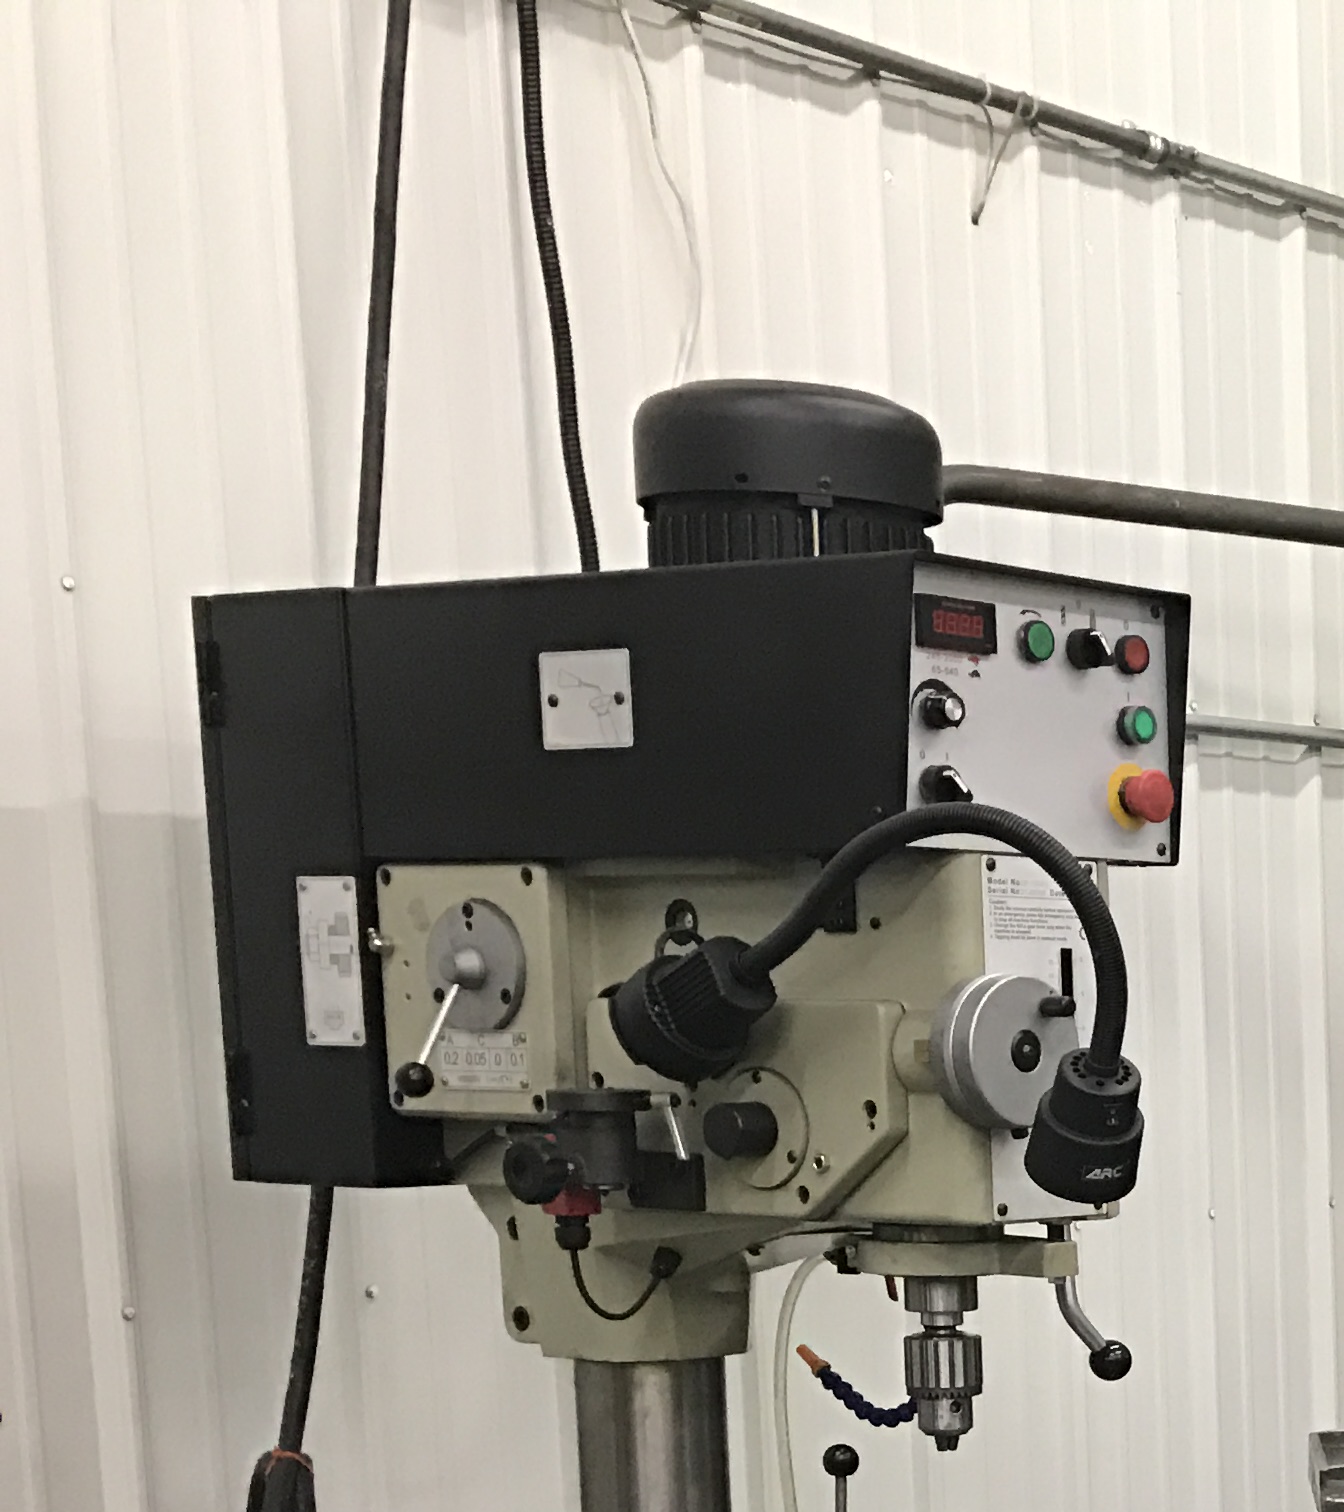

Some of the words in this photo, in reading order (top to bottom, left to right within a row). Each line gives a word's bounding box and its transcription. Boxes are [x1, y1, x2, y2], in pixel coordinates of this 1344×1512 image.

[446, 1035, 454, 1045] A
[477, 1034, 485, 1047] C
[494, 1053, 502, 1066] 0
[1085, 1165, 1124, 1180] ARC
